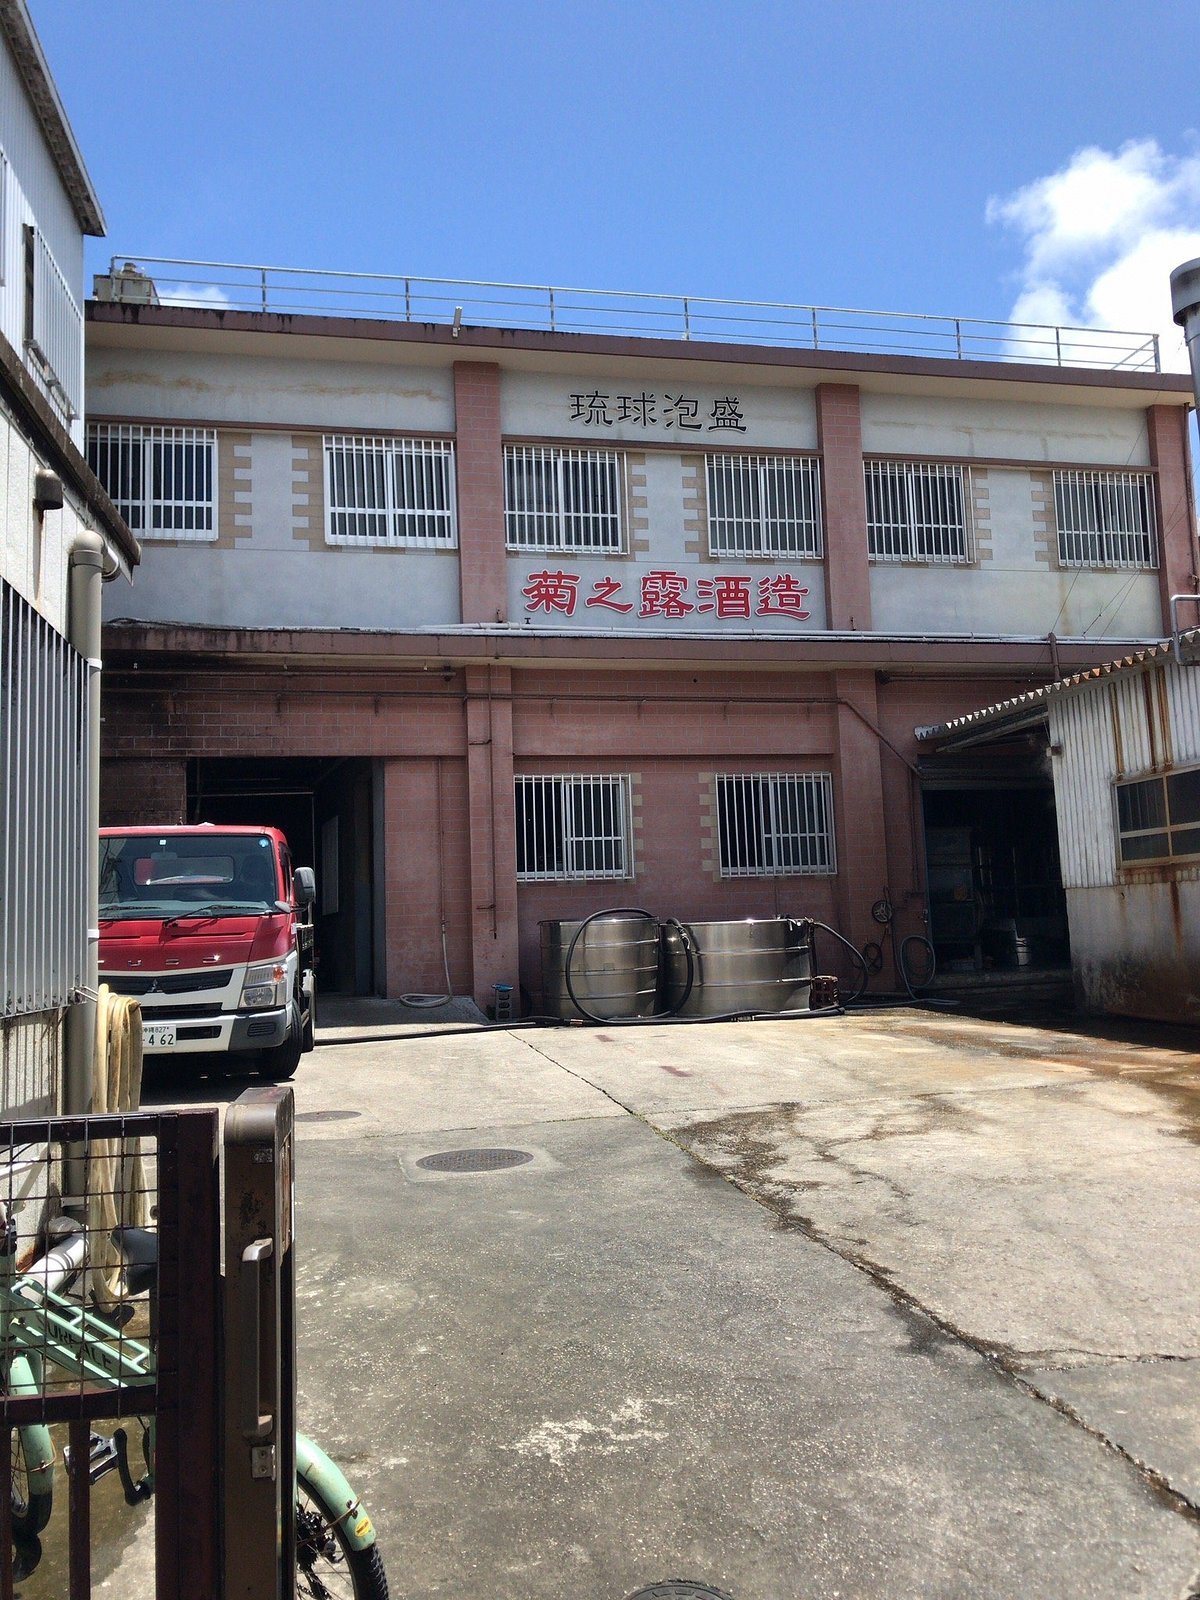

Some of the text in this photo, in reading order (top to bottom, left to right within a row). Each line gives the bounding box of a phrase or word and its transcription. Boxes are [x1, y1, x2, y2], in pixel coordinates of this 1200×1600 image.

[569, 389, 747, 432] 琉球泡盛
[521, 569, 811, 620] 菊之露酒造
